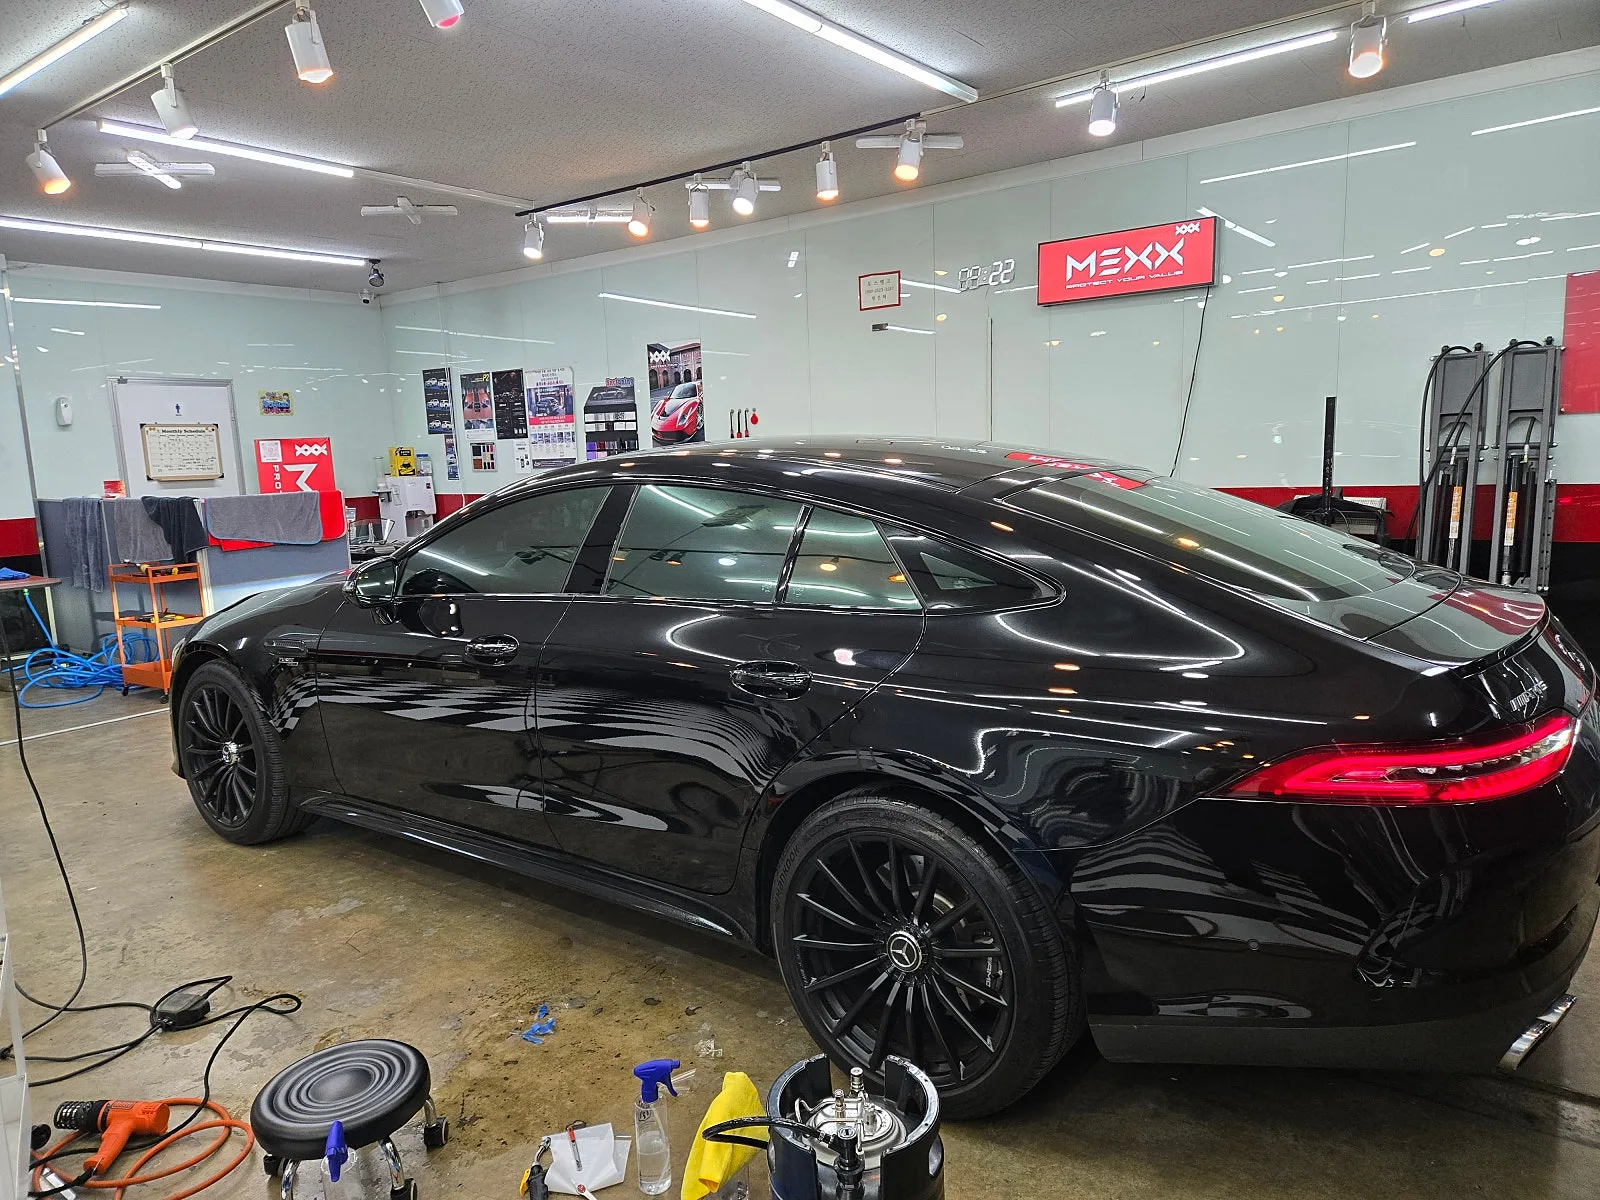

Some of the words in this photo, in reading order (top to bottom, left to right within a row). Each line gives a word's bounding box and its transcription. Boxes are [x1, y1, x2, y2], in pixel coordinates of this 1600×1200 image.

[1065, 237, 1185, 282] MEXX
[1065, 279, 1113, 290] PROTECT
[1117, 275, 1145, 283] YOUR
[1149, 270, 1184, 279] VALUE
[272, 464, 283, 494] PRO
